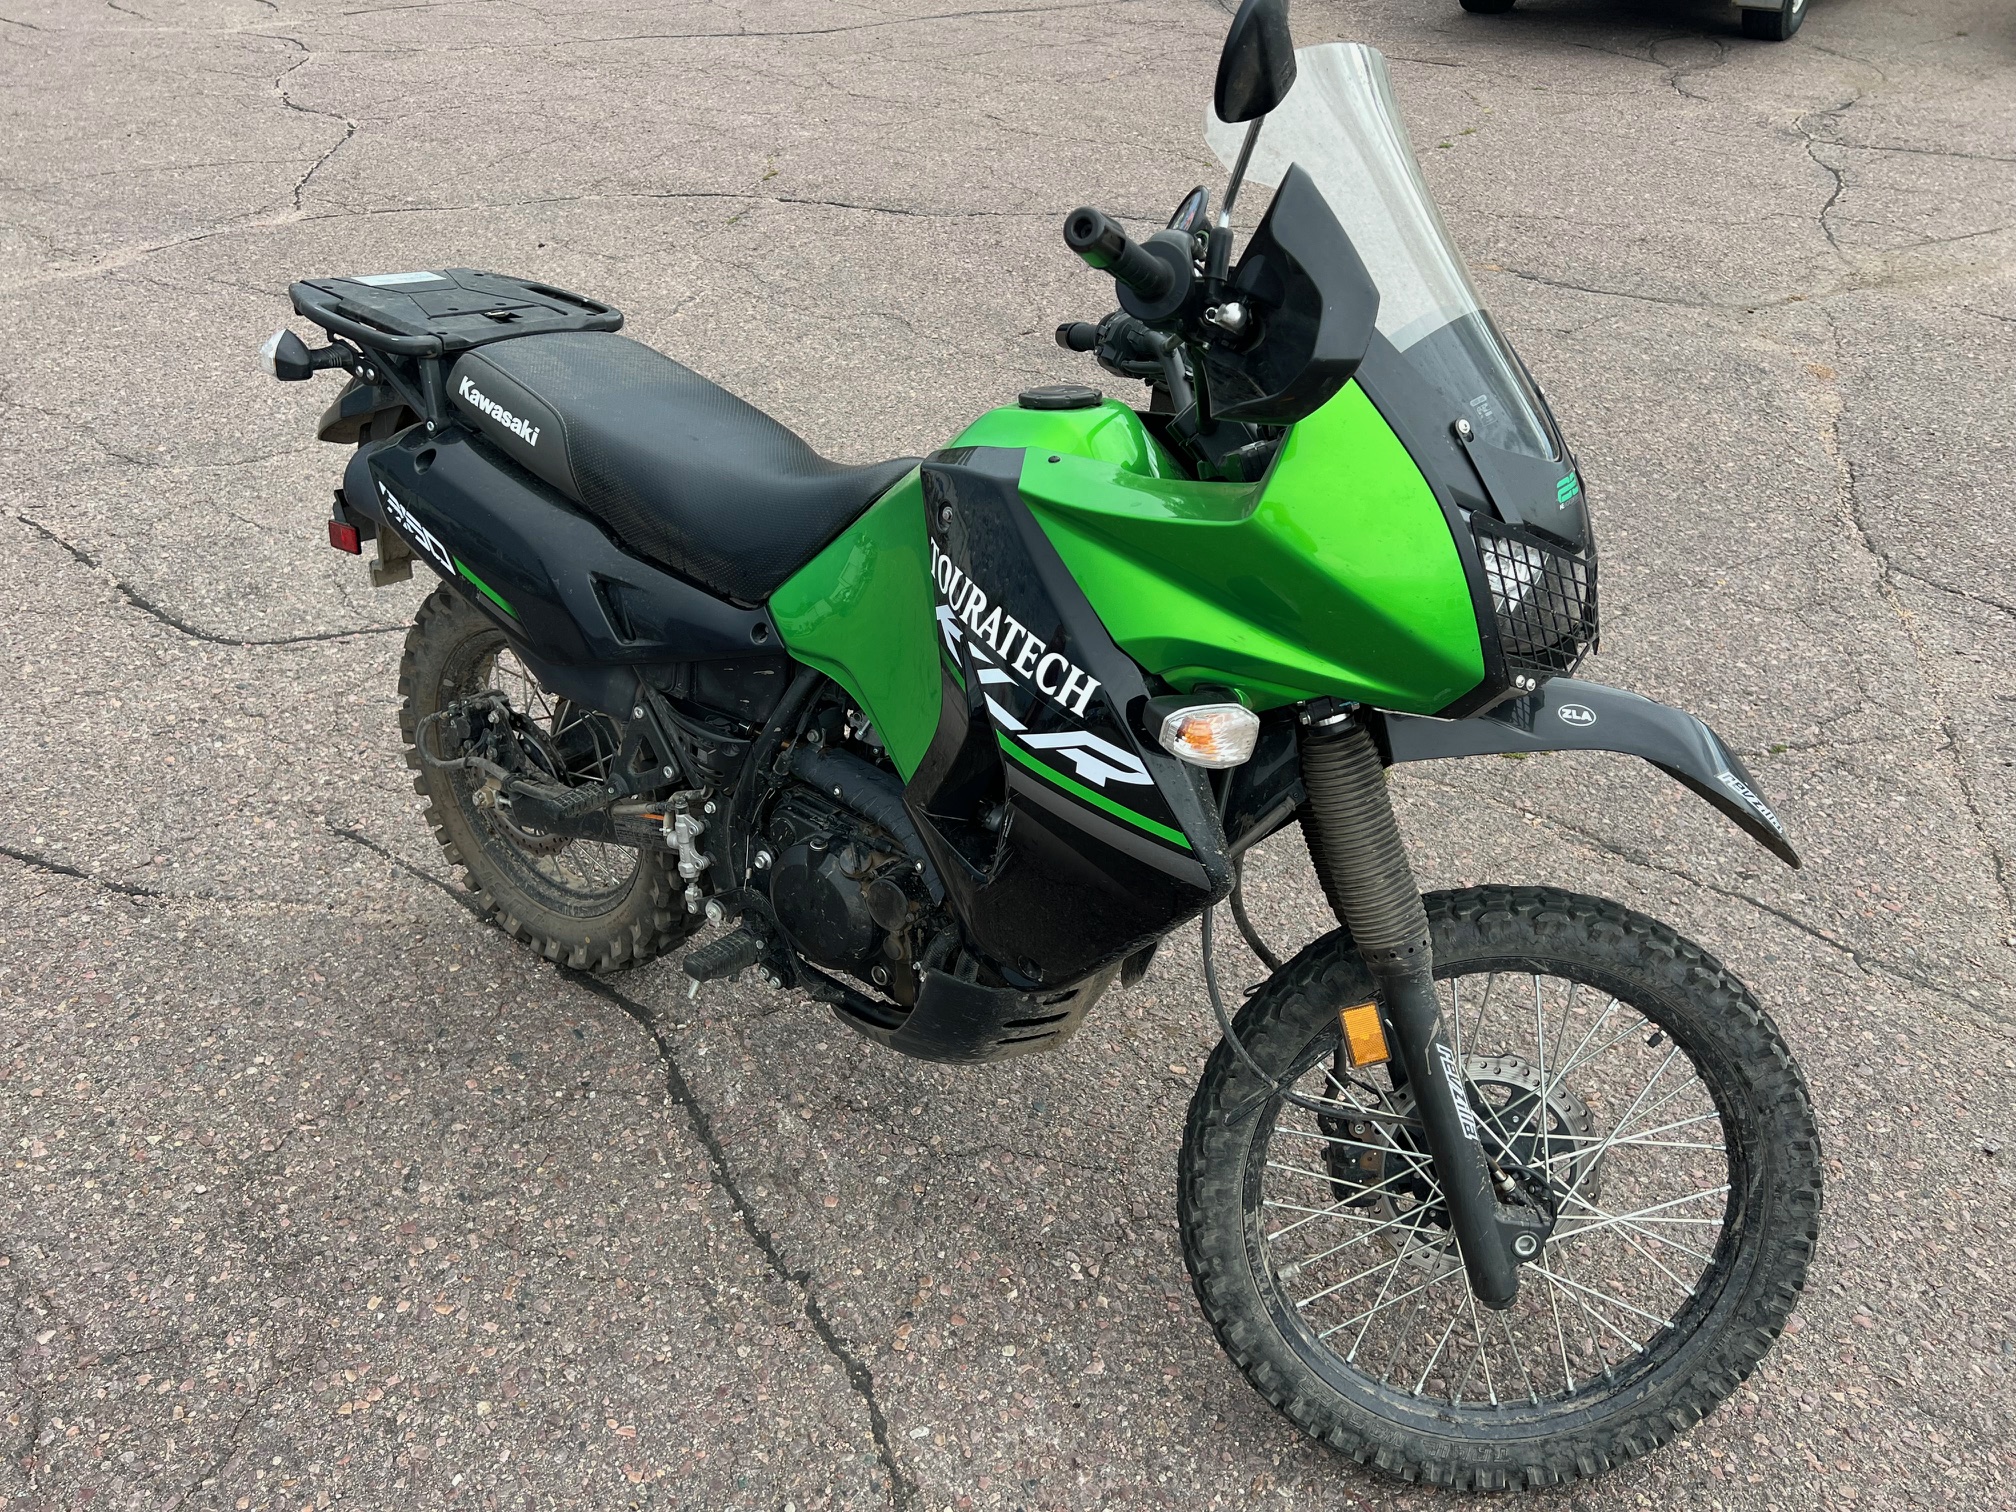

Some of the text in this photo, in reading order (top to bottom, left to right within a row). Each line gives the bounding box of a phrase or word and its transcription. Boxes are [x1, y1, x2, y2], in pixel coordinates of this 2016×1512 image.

[458, 375, 541, 447] Kawasaki
[930, 536, 1102, 719] TOURATECH
[1561, 708, 1593, 722] ZLA
